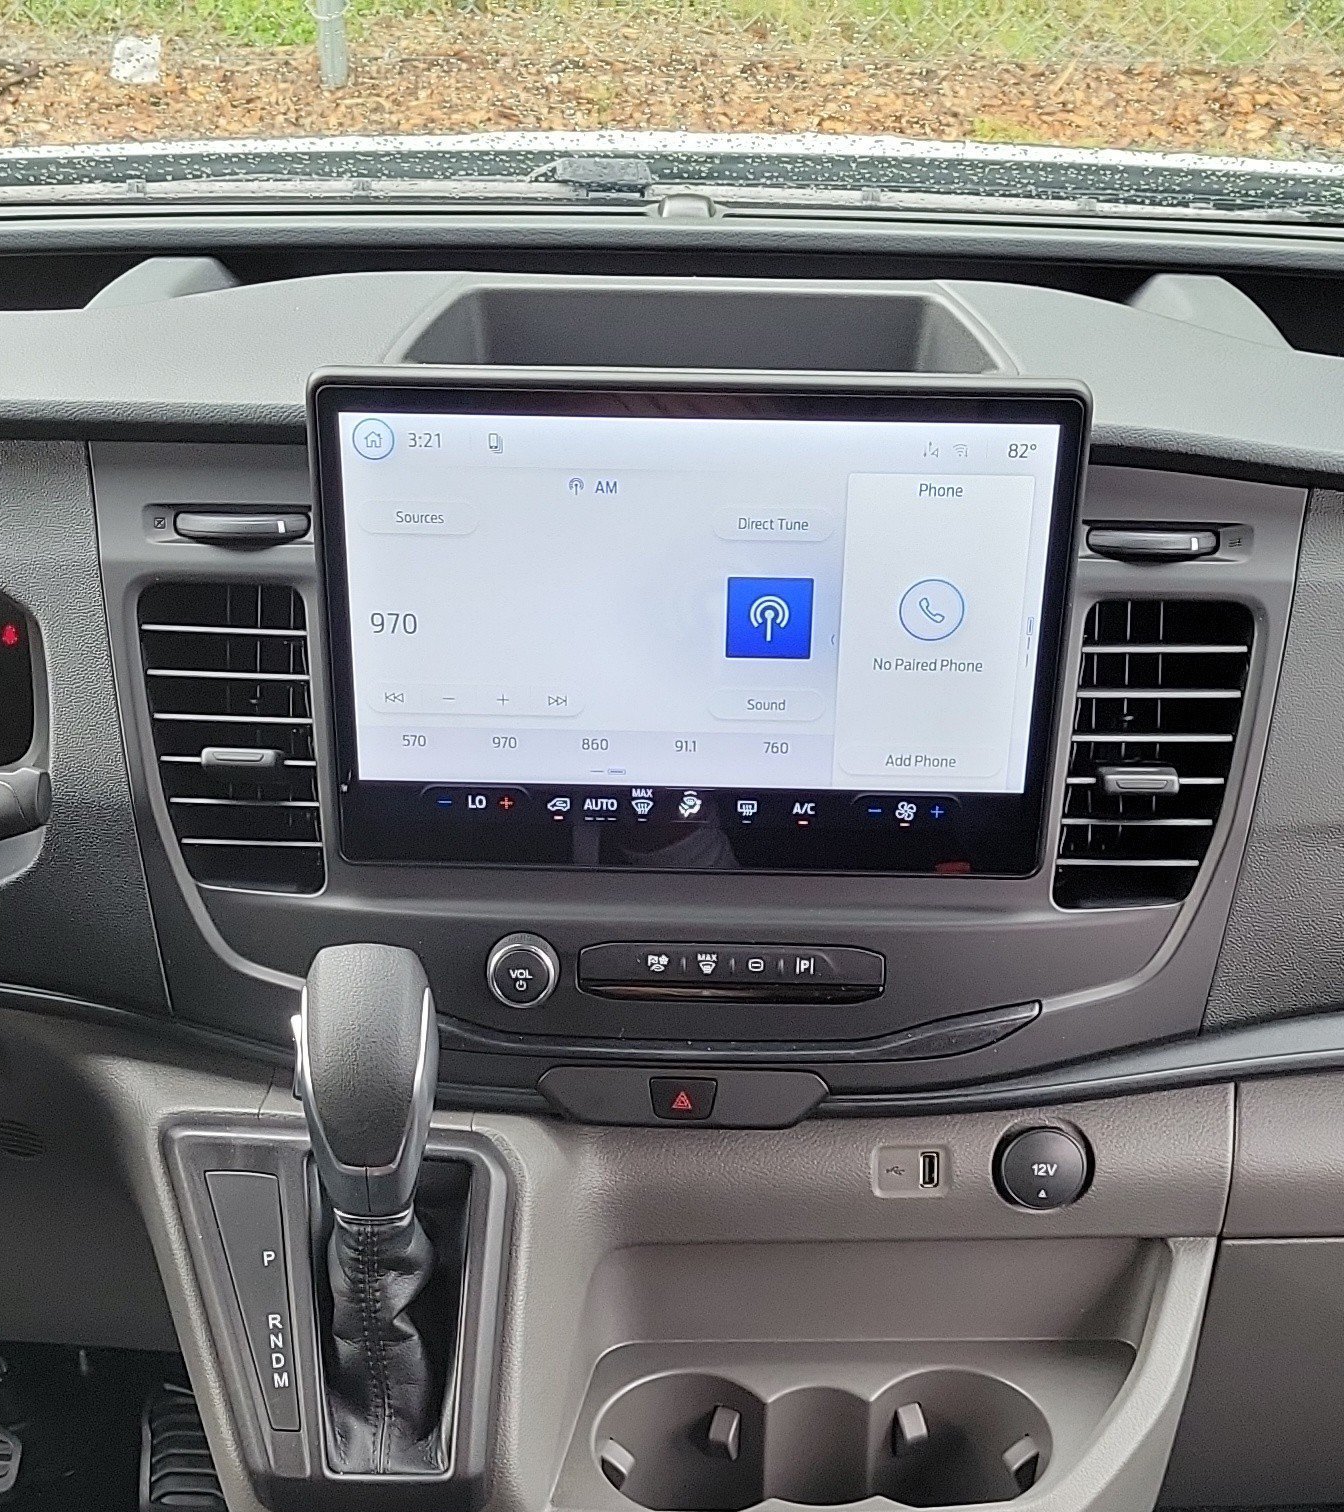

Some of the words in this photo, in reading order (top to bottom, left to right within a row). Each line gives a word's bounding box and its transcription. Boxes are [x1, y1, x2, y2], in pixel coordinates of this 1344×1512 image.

[407, 432, 442, 449] 3:21
[594, 480, 618, 494] AM
[918, 483, 963, 498] Phone
[395, 511, 444, 524] Sources
[737, 517, 774, 531] Direct
[777, 518, 809, 531] Tune
[370, 612, 418, 635] 970
[873, 658, 892, 671] No
[895, 658, 937, 672] Paired
[939, 658, 983, 673] Phone
[746, 698, 786, 711] Sound
[402, 734, 427, 748] 570
[492, 736, 517, 749] 970
[581, 738, 609, 751] 860
[675, 740, 697, 753] 91.1
[763, 741, 789, 755] 760
[885, 754, 911, 767] Add
[914, 754, 957, 768] Phone
[631, 788, 653, 798] MAX
[467, 795, 487, 810] LO
[583, 798, 618, 812] AUTO
[792, 802, 816, 816] A/C
[697, 953, 717, 962] MAX
[509, 968, 533, 979] VOL
[1031, 1163, 1058, 1176] 12V
[263, 1251, 276, 1266] P
[268, 1314, 283, 1329] R
[270, 1333, 284, 1349] N
[272, 1353, 285, 1369] D
[273, 1372, 289, 1389] M
